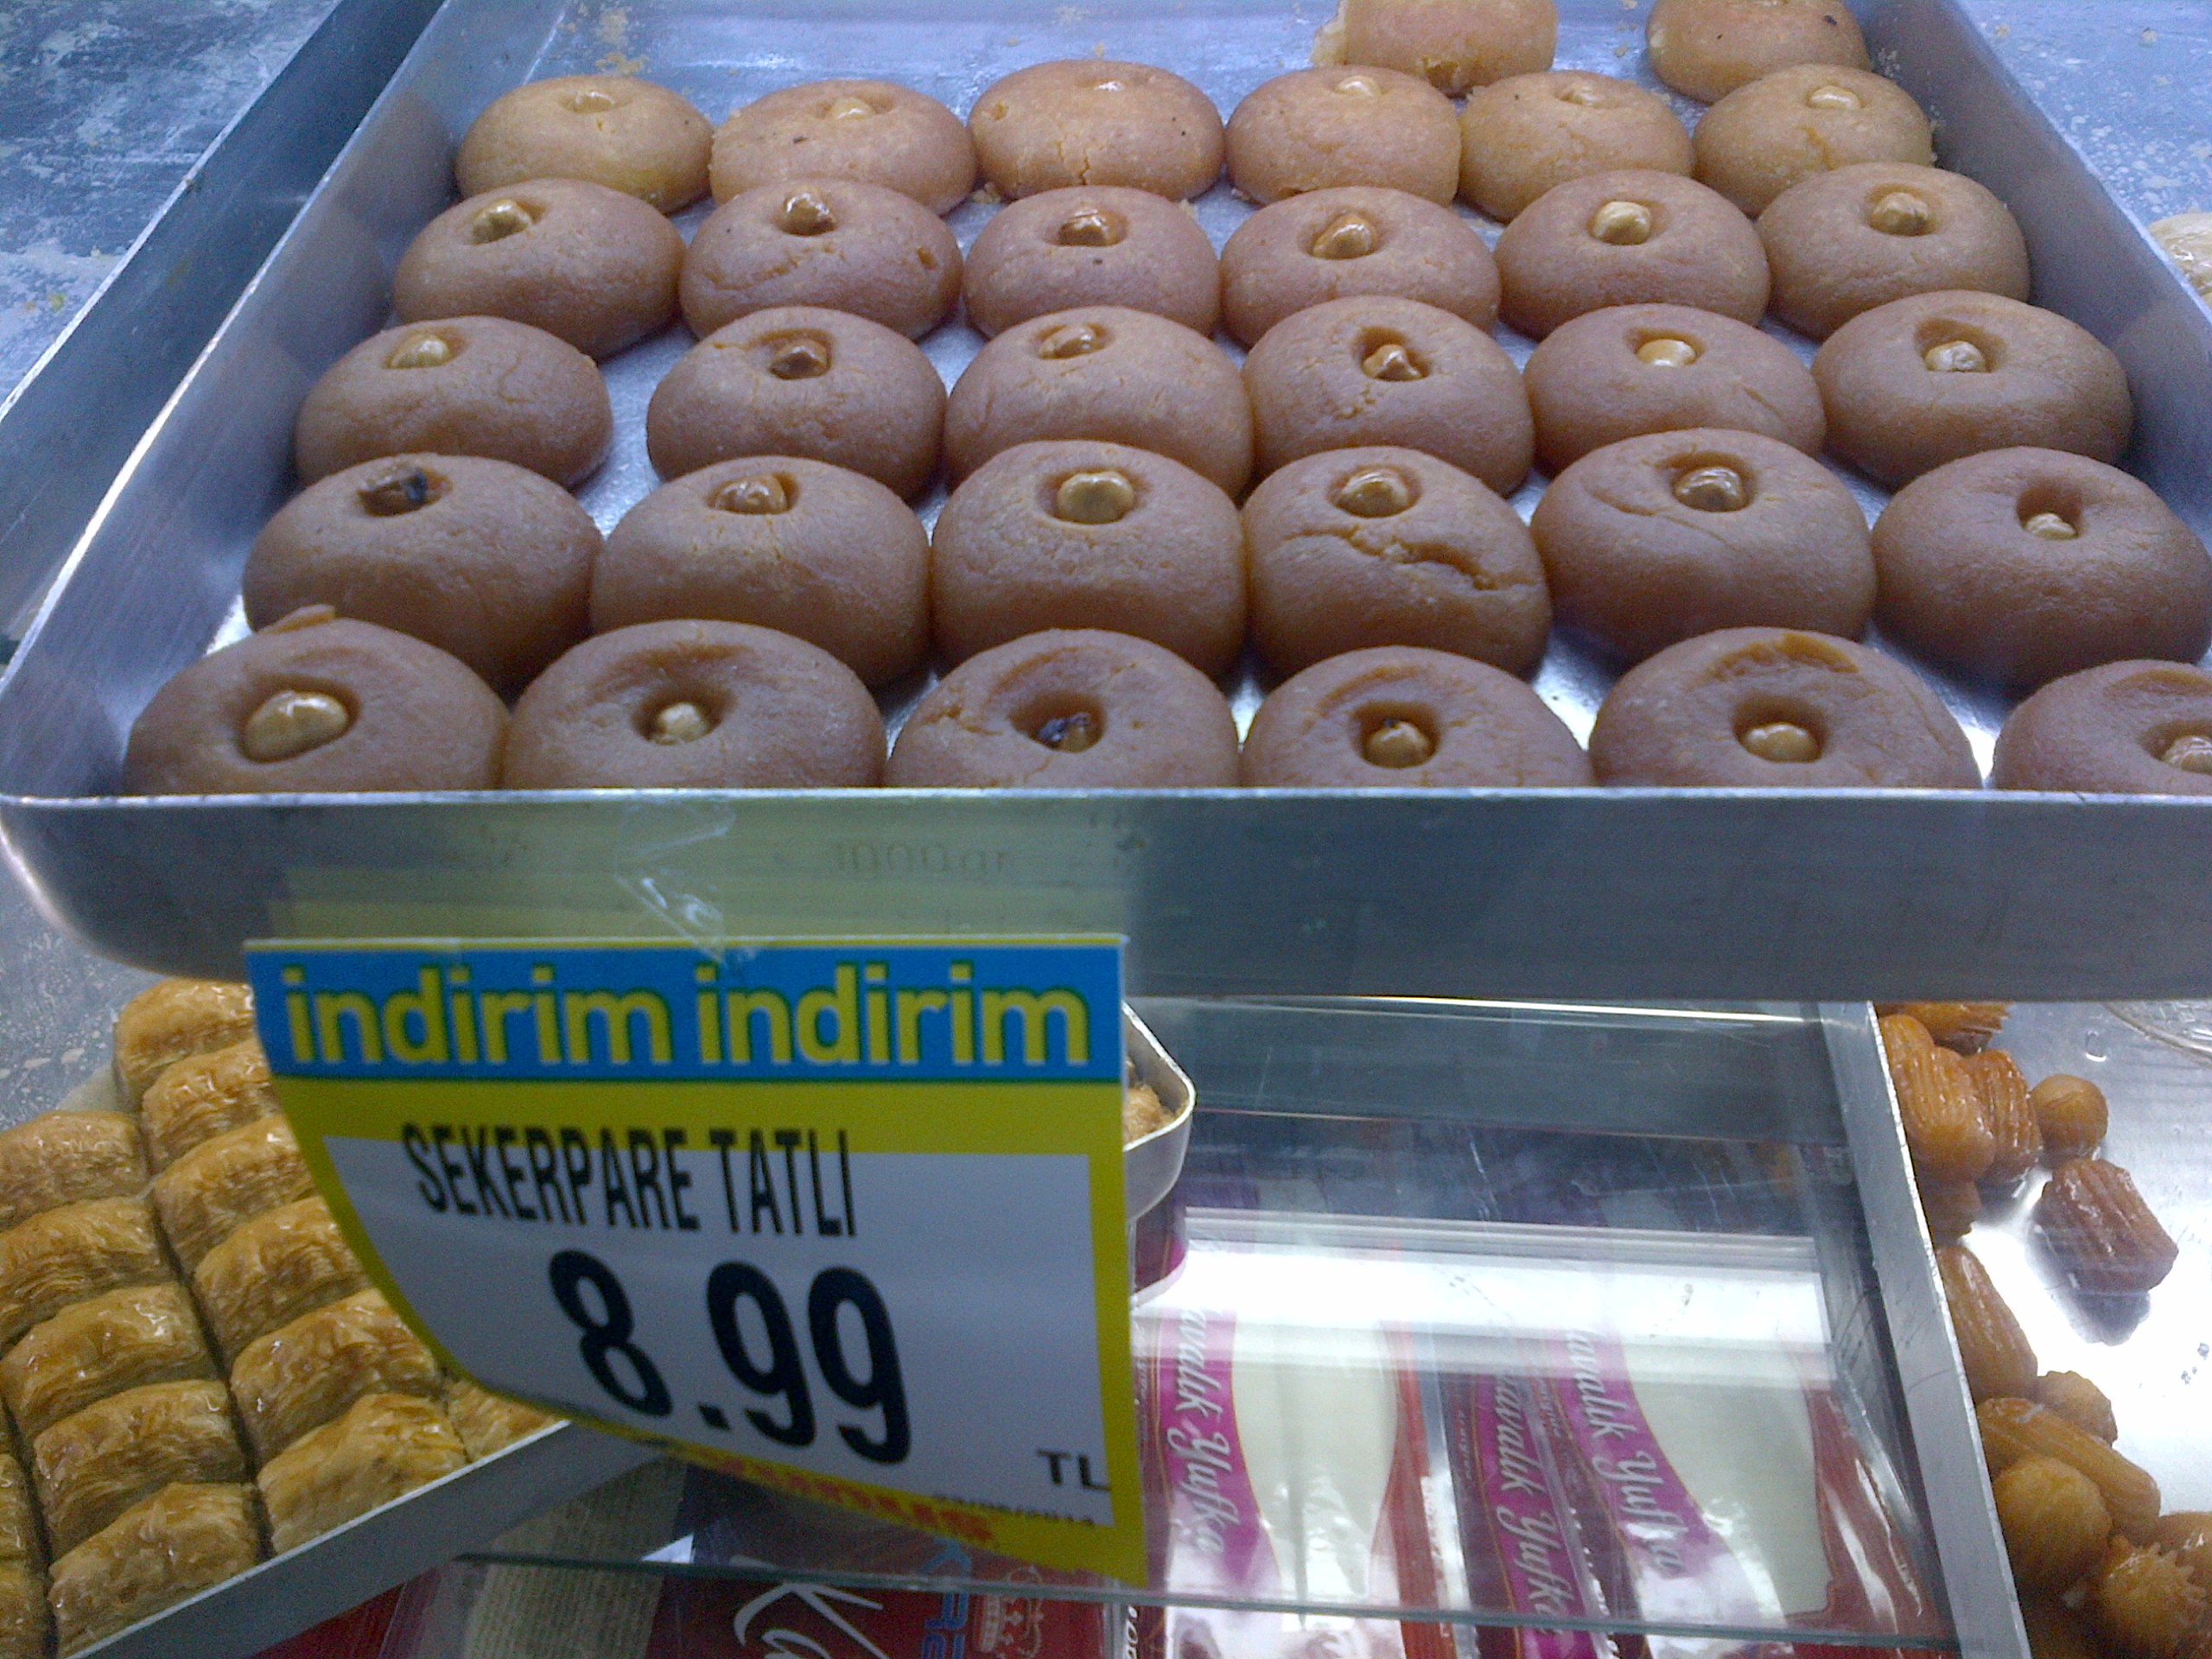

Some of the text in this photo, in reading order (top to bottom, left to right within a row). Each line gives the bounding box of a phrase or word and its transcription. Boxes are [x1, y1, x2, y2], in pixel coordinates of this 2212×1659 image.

[281, 959, 1090, 1069] indirim indirim
[401, 1122, 857, 1237] SEKERPARE TATLI
[549, 1249, 1112, 1493] 8.99 TL
[1593, 1451, 1688, 1570] Yufa
